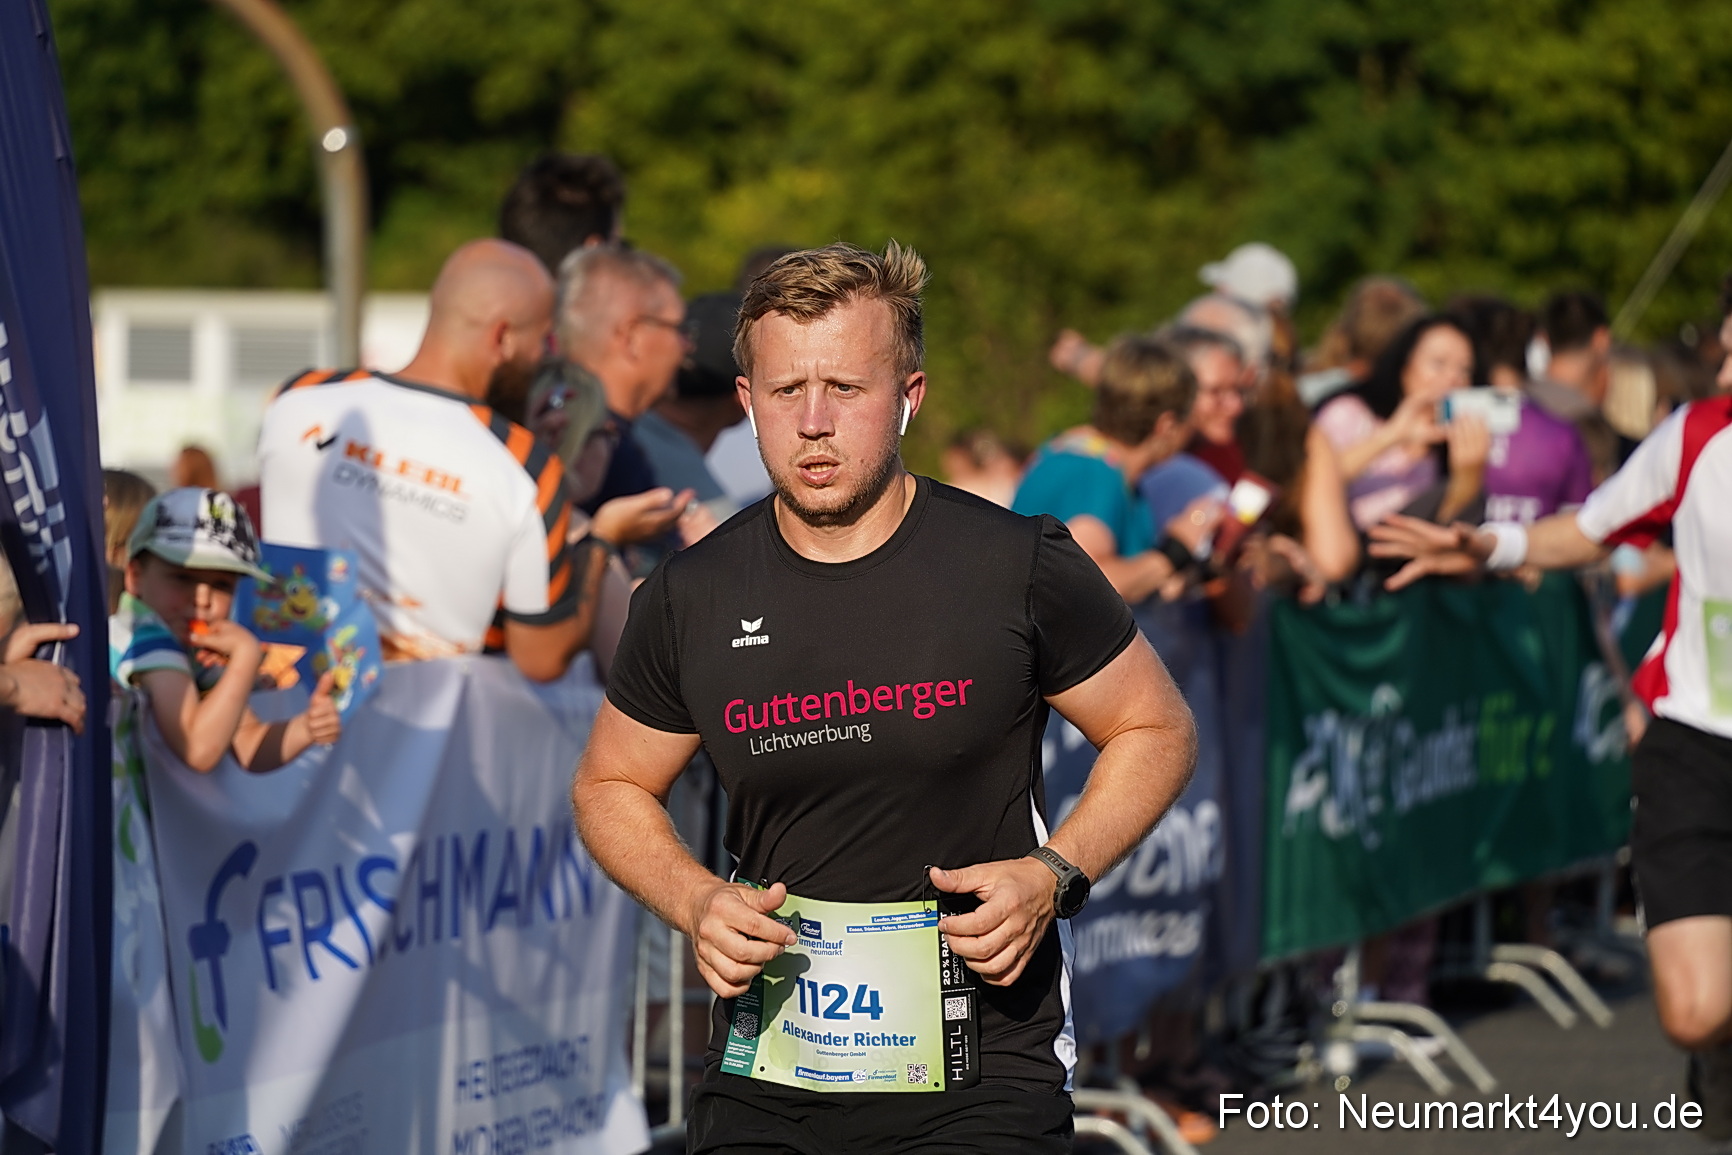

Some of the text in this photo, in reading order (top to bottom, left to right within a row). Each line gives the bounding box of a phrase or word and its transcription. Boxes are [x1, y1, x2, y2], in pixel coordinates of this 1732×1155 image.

[732, 635, 769, 647] erima
[724, 679, 972, 733] Guttenberger
[750, 723, 872, 755] Lichtwerbung
[257, 820, 594, 991] FRISCHMANN
[797, 935, 843, 950] irmenlauf
[942, 959, 950, 968] %
[943, 969, 951, 985] 20
[795, 975, 884, 1020] 1124
[782, 1020, 917, 1047] Alexander Richter
[815, 1048, 849, 1058] Guttenberger
[949, 1025, 964, 1081] HILTL
[797, 1068, 850, 1082] firmenlauf.bayern
